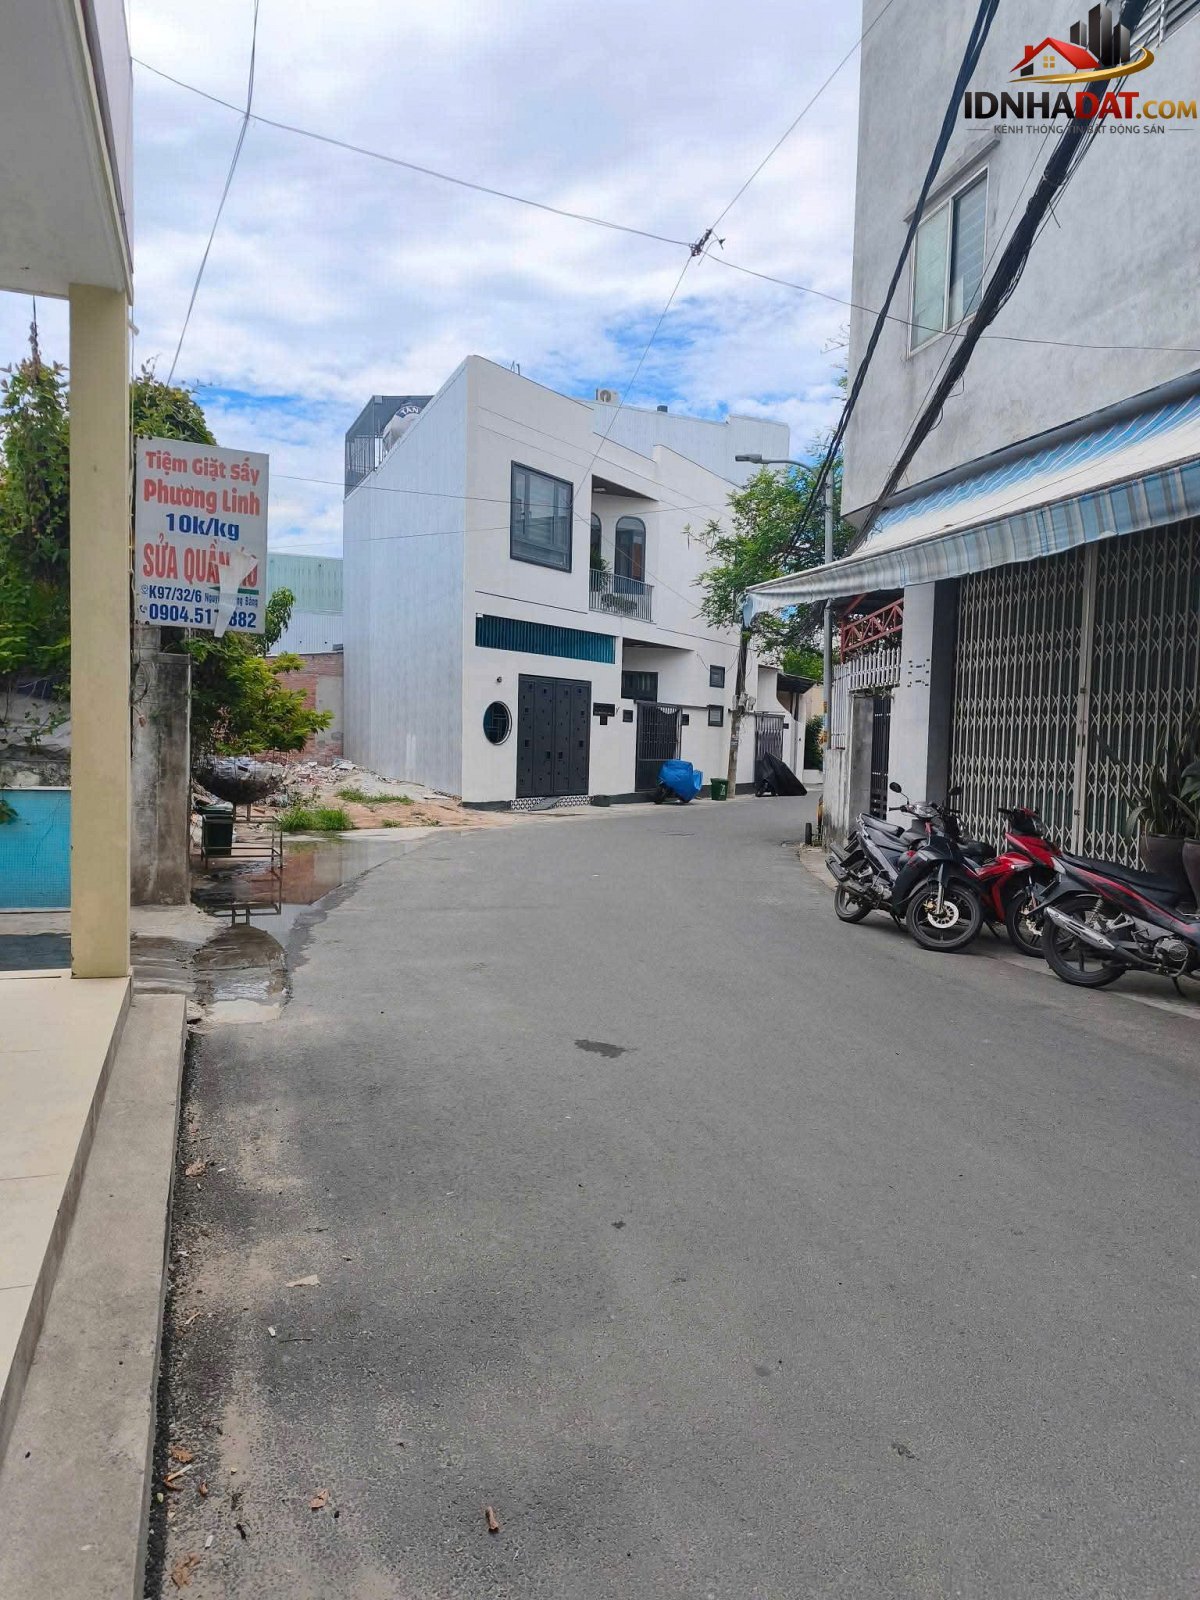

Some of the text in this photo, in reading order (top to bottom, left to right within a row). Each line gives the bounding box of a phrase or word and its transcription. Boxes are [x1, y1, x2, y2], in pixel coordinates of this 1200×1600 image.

[145, 450, 188, 476] Tiệm
[192, 457, 226, 482] Giặt
[143, 478, 260, 516] Phương Linh
[165, 512, 240, 541] 10k/kg
[142, 532, 178, 580] SỬA
[149, 584, 202, 604] K97/32/6
[149, 603, 257, 629] 0904.51882
